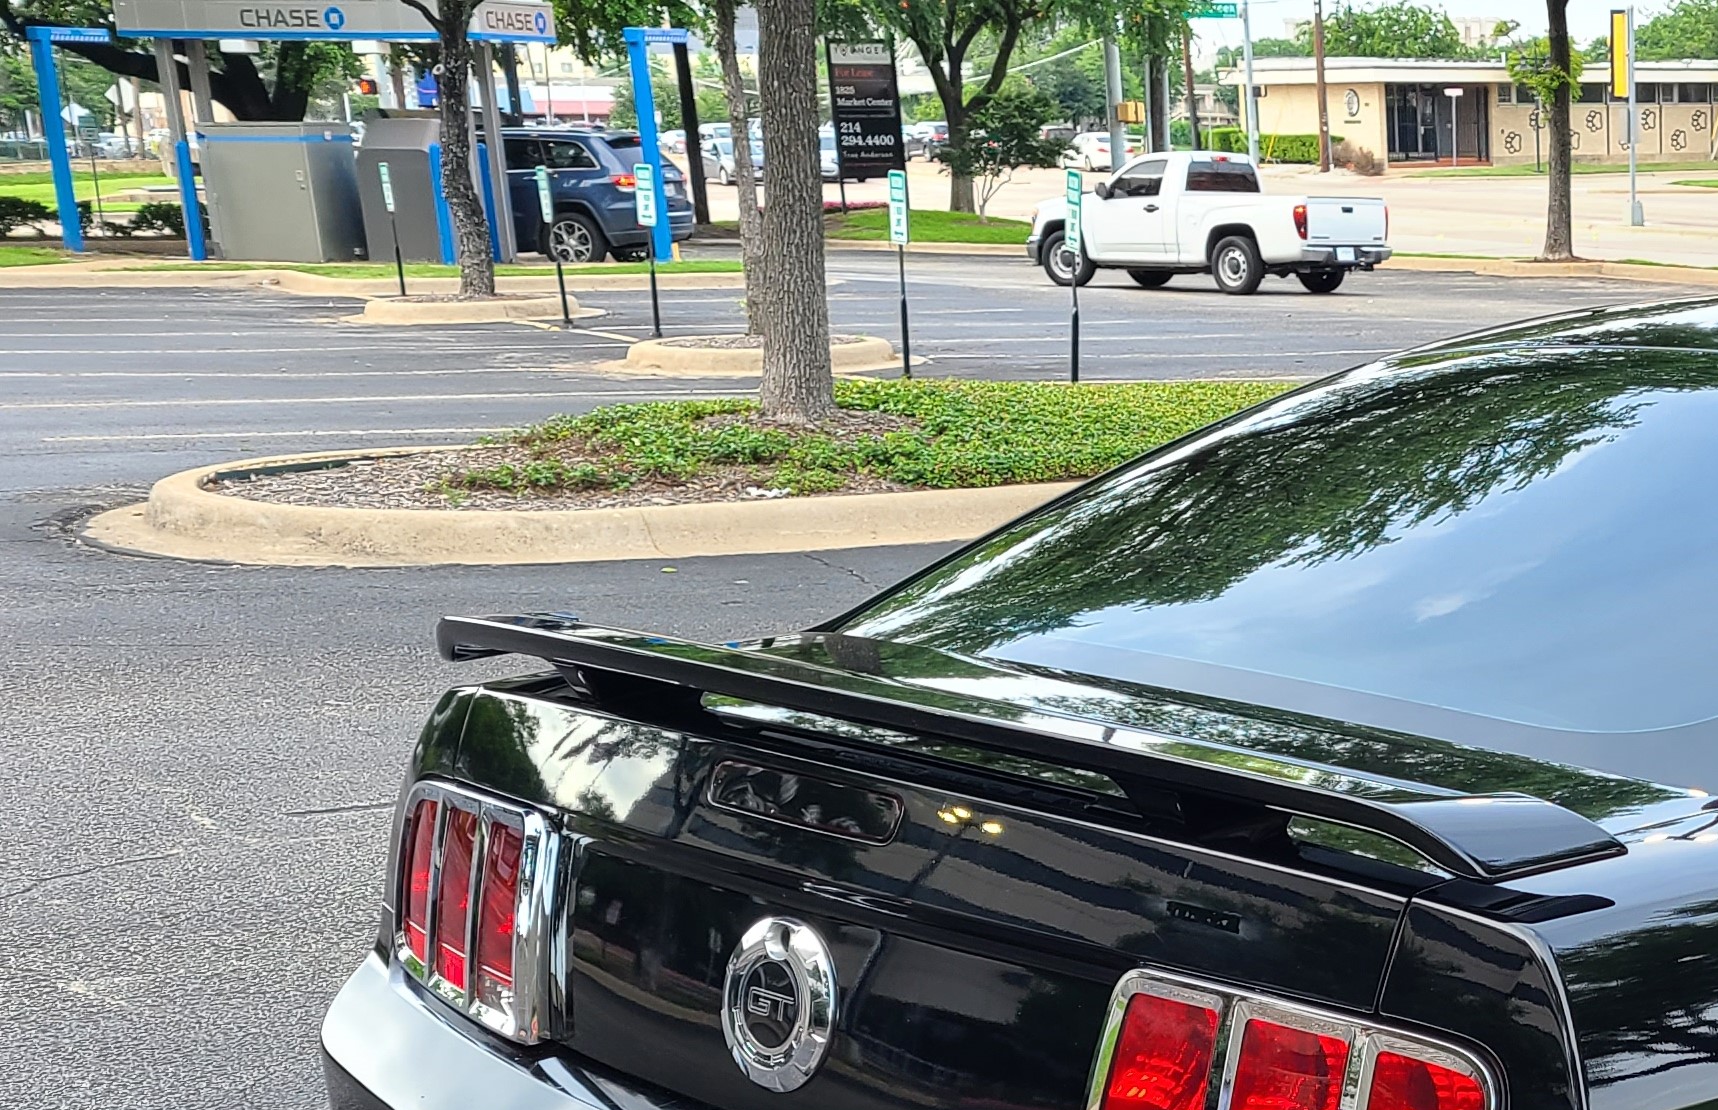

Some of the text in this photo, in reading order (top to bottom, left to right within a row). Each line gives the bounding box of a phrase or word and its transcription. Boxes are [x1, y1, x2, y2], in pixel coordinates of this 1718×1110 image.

[240, 8, 321, 27] CHASE
[486, 11, 533, 31] CHASE
[837, 97, 893, 107] Market Center
[840, 122, 861, 133] 214
[841, 135, 895, 146] 294.4400
[747, 986, 795, 1021] GT
